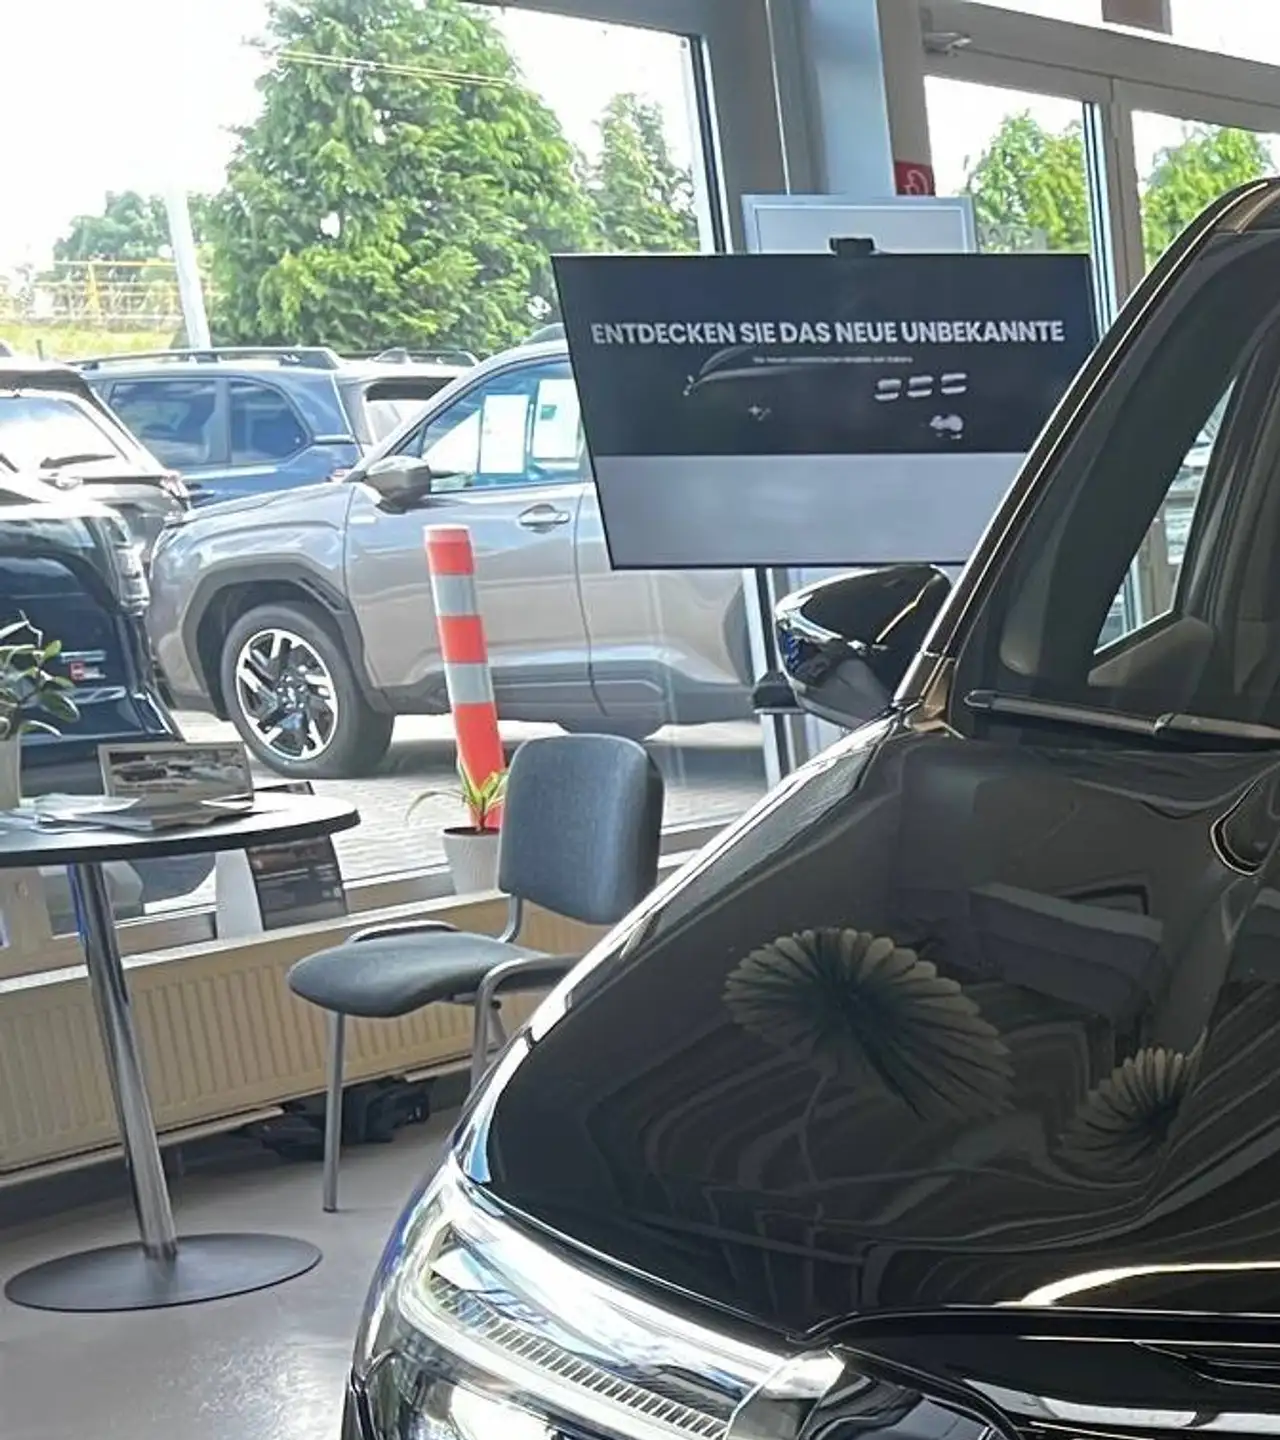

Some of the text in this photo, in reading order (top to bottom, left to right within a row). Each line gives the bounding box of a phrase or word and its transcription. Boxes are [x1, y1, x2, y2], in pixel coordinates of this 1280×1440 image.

[591, 320, 1065, 344] ENTDECKEN SIE DAS NEUE UNBEKANNTE
